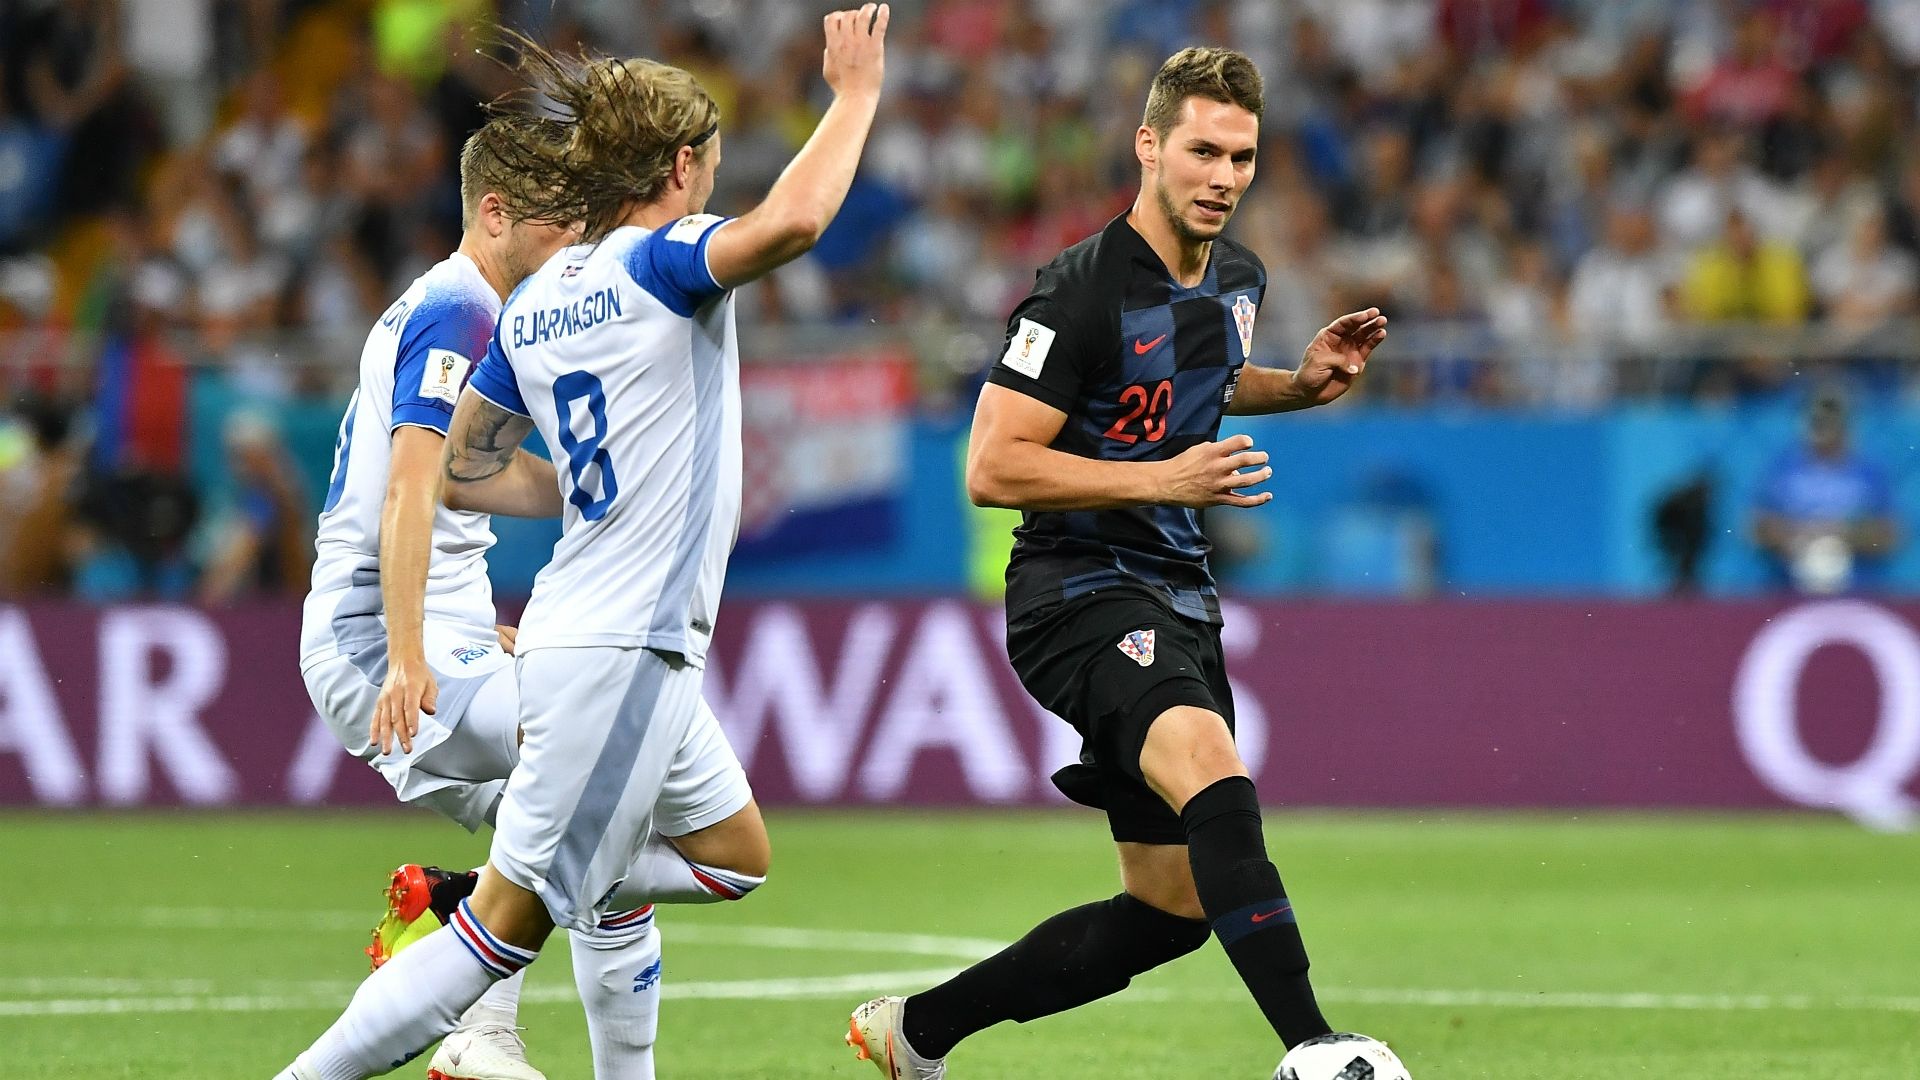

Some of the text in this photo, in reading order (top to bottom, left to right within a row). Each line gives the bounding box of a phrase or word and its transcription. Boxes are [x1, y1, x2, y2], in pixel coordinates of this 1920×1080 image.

[514, 284, 622, 349] BJARNASON
[1103, 380, 1174, 444] 20
[552, 369, 619, 522] 8
